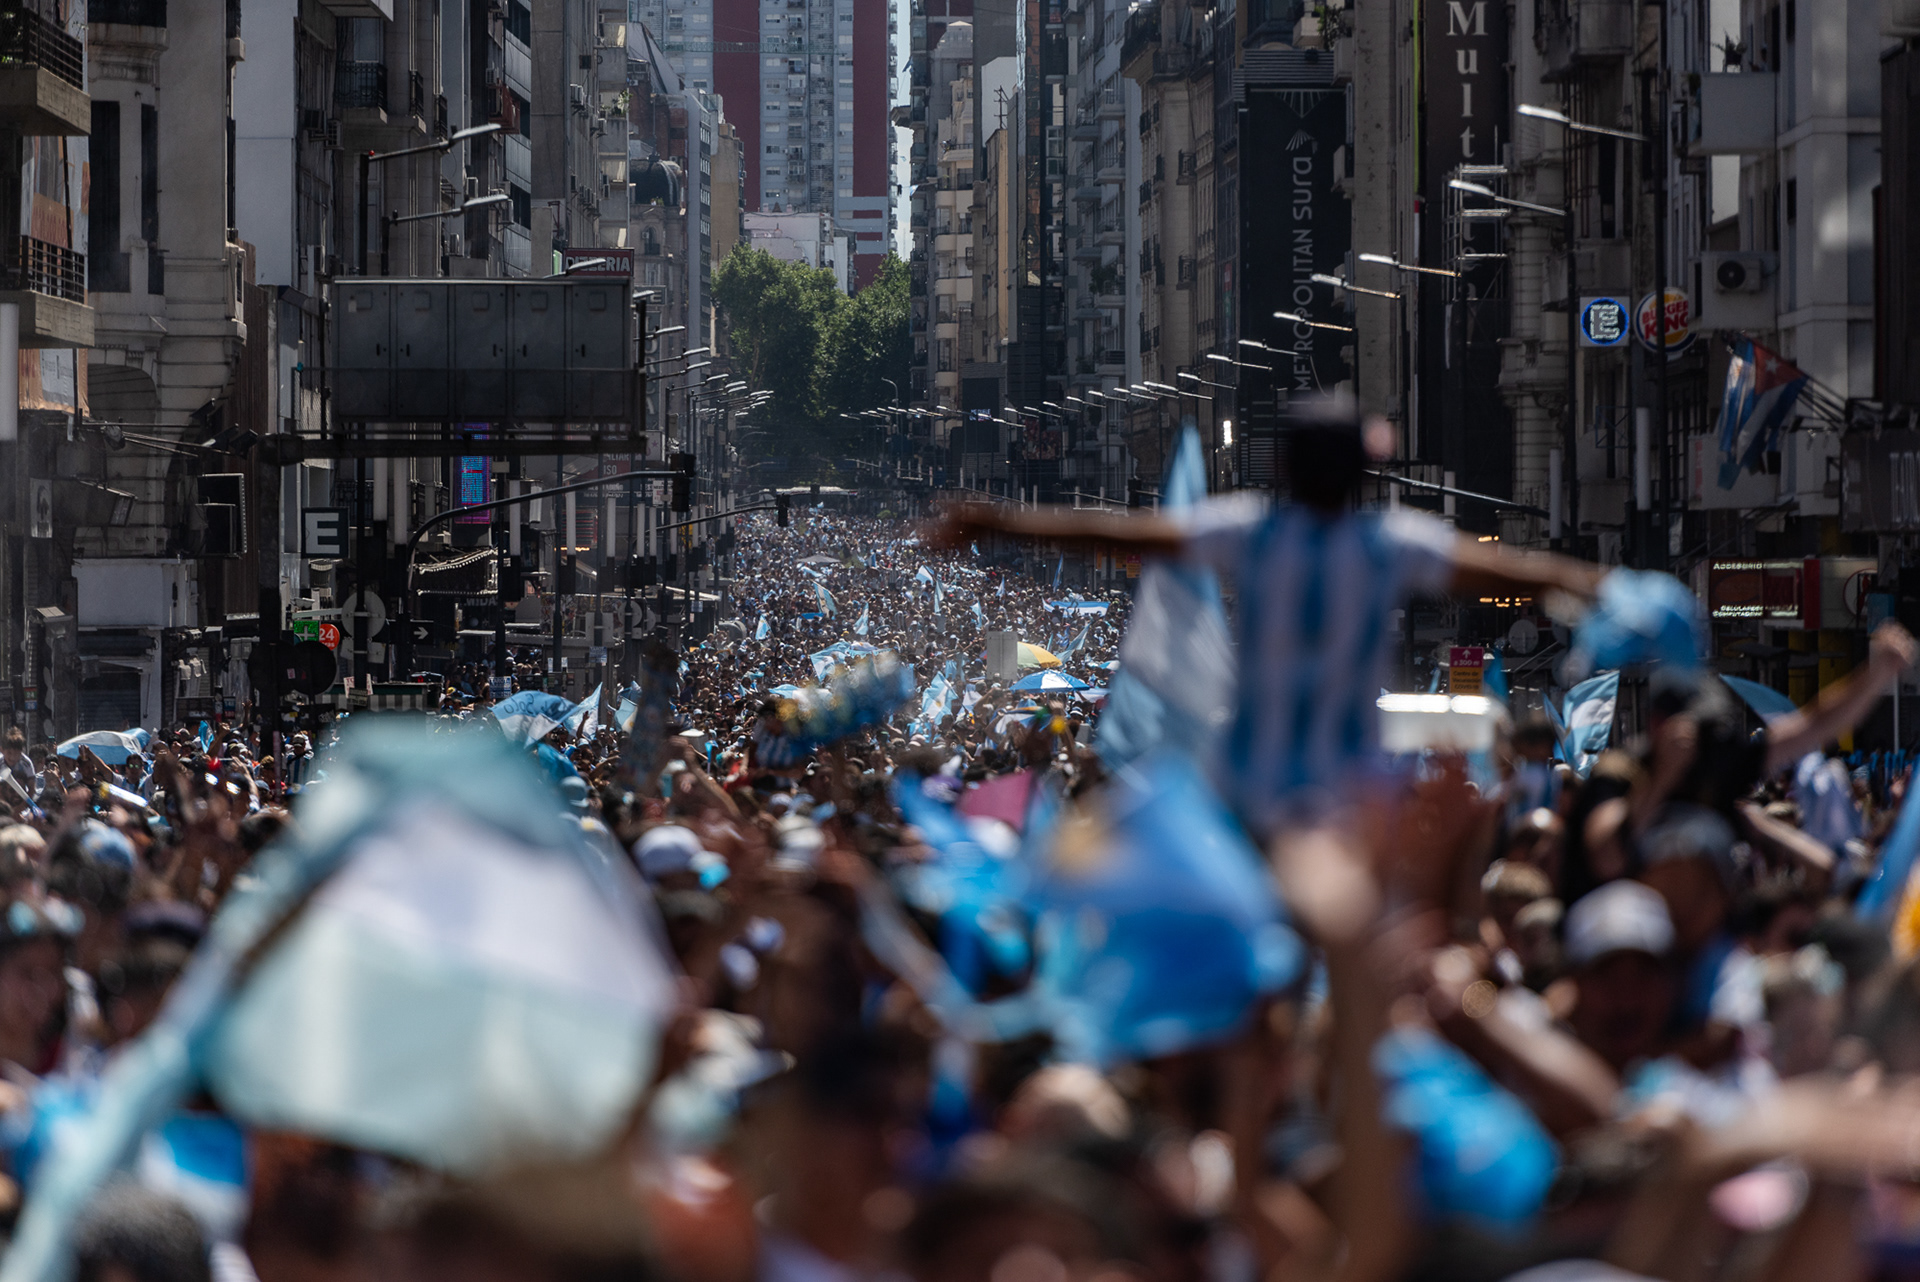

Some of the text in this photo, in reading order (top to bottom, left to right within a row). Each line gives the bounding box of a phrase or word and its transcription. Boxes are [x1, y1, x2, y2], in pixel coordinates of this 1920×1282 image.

[1292, 156, 1314, 391] METROPOLITAN sura
[1589, 303, 1621, 340] E
[1644, 311, 1689, 340] KNG
[305, 512, 340, 555] E
[320, 628, 335, 641] 24
